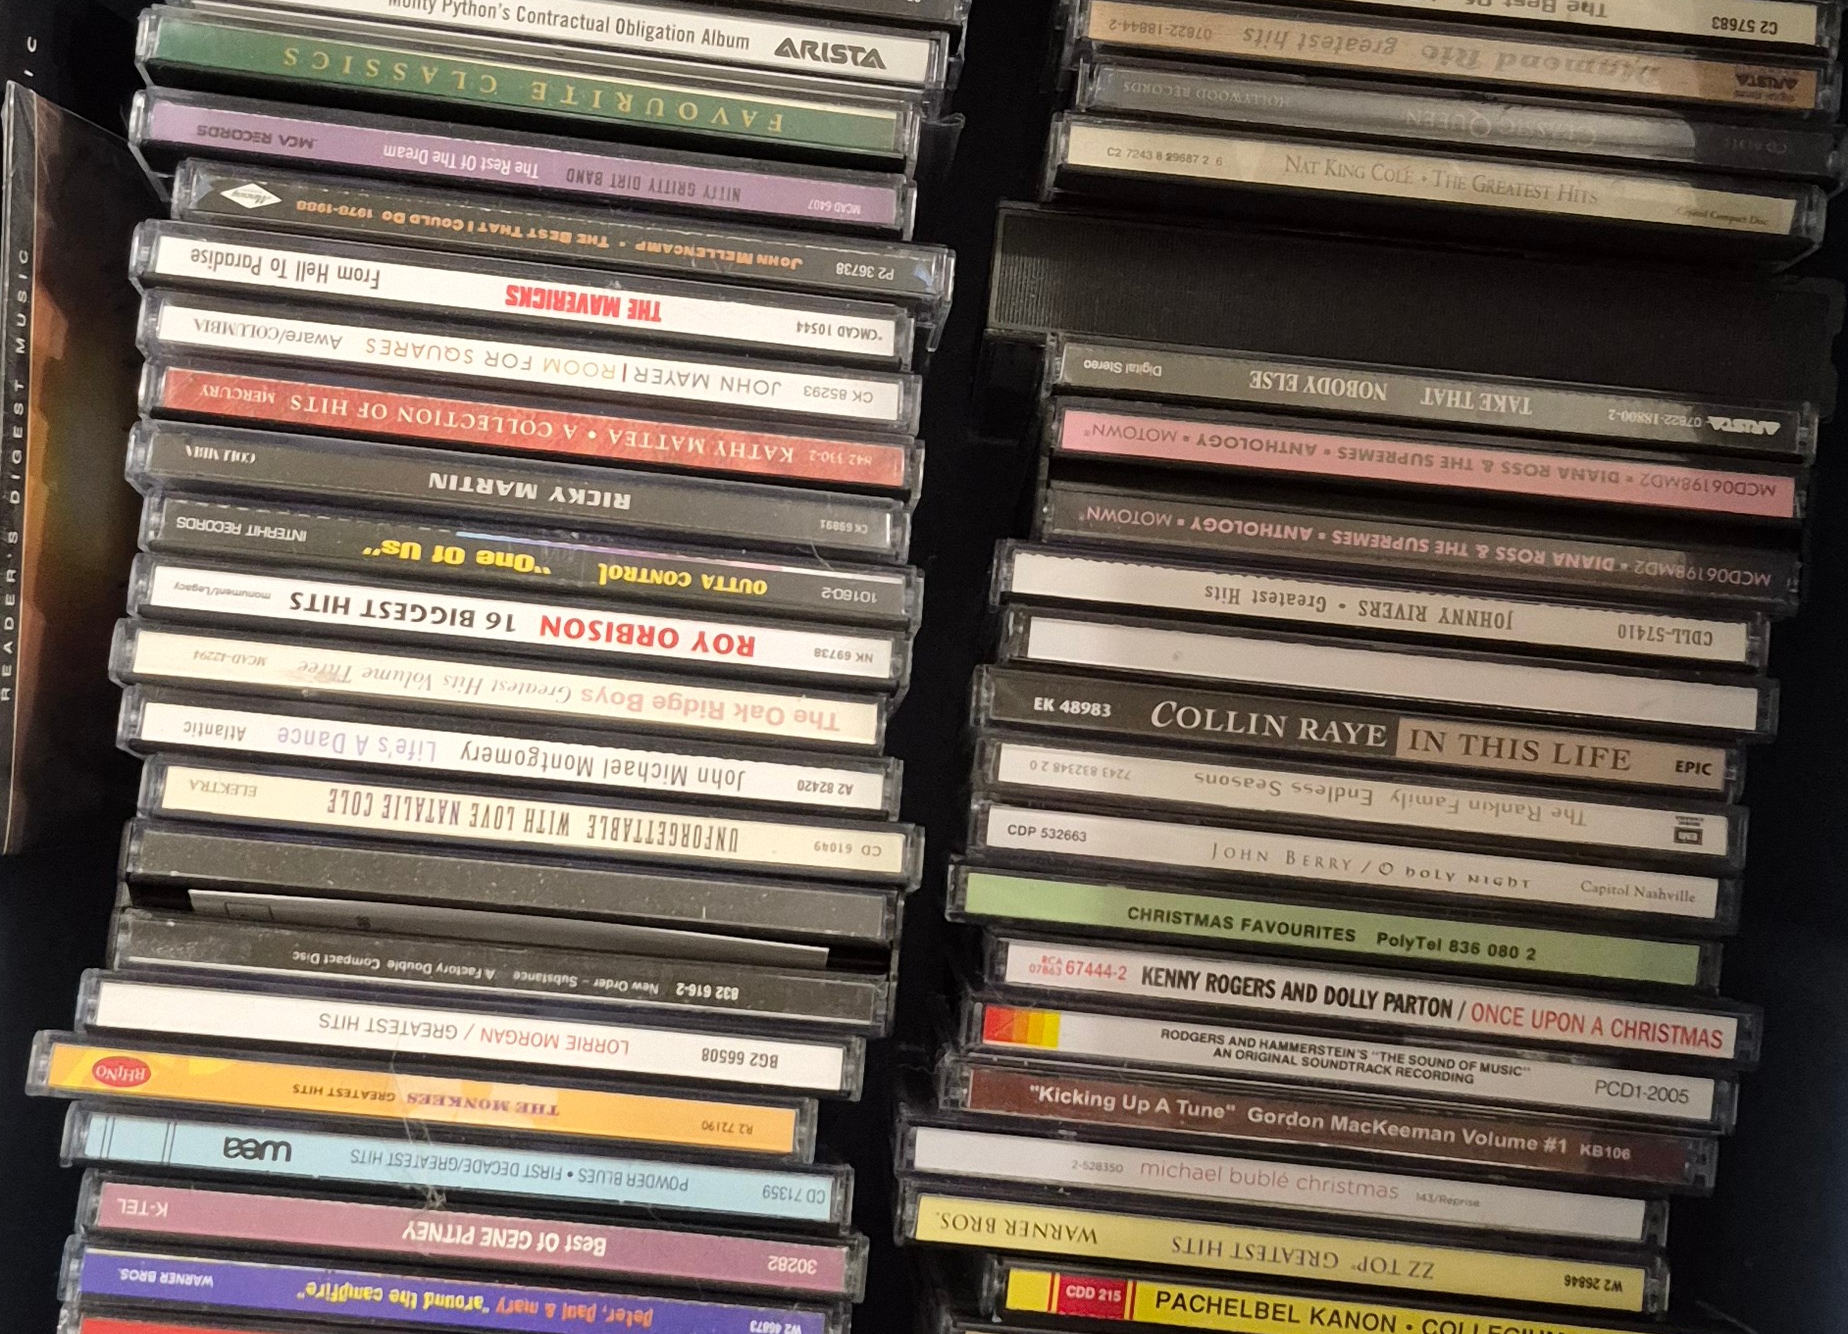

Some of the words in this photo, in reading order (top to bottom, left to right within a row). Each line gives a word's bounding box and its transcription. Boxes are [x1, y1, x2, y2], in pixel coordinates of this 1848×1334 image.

[1566, 0, 1607, 18] The
[516, 5, 609, 32] Contractual
[615, 17, 694, 43] Obligation
[701, 28, 749, 49] Album
[774, 37, 887, 69] ARISTA
[190, 248, 261, 275] Paradise
[270, 257, 287, 279] To
[295, 260, 329, 283] Hell
[337, 265, 380, 289] From
[504, 284, 622, 317] MAVERICKS
[626, 298, 663, 322] THE
[1249, 370, 1298, 391] ELSE
[1302, 375, 1387, 400] NOBODY
[1420, 387, 1474, 409] THAT
[1479, 392, 1531, 414] TAKE
[608, 428, 704, 454] MATTEA
[714, 440, 793, 462] KATHY
[428, 472, 537, 499] MARTIN
[548, 486, 630, 509] RICKY
[289, 591, 350, 615] HITS
[359, 599, 475, 627] BIGGEST
[485, 611, 515, 632] 16
[539, 615, 679, 648] ORBISON
[690, 630, 755, 657] ROY
[1617, 624, 1712, 646] CDLL-57410
[1033, 696, 1054, 711] EK
[1059, 699, 1110, 717] 48983
[1150, 700, 1287, 737] COLLIN
[1298, 717, 1386, 746] RAYE
[460, 740, 593, 777] Montgomery
[1408, 729, 1446, 752] IN
[1458, 733, 1539, 761] THIS
[1552, 742, 1630, 770] LIFE
[603, 758, 687, 786] Michael
[697, 767, 745, 791] John
[1675, 760, 1712, 775] EPIC
[1127, 906, 1233, 929] CHRISTMAS
[1240, 917, 1355, 942] FAVOURITES
[1376, 931, 1441, 951] PolyTel
[1448, 939, 1480, 954] 836
[1487, 943, 1519, 959] 080
[1526, 947, 1536, 961] 2
[1141, 966, 1200, 990] KENNY
[1205, 972, 1275, 998] ROGERS
[1280, 980, 1317, 1003] AND
[1323, 985, 1378, 1009] DOLLY
[1382, 991, 1452, 1018] PARTON
[1471, 1002, 1524, 1026] ONCE
[1531, 1009, 1584, 1033] UPON
[1590, 1016, 1603, 1035] A
[1610, 1018, 1723, 1049] CHRISTMAS
[701, 1047, 744, 1065] 66508
[749, 1052, 778, 1068] BG2
[407, 1093, 508, 1111] MONKEES
[1594, 1079, 1688, 1104] PCD1-2005
[516, 1102, 560, 1116] THE
[1029, 1084, 1115, 1111] "Kicking
[1122, 1093, 1150, 1114] Up
[1154, 1097, 1170, 1113] A
[1176, 1099, 1235, 1118] Tune"
[1247, 1106, 1323, 1128] Gordon
[1330, 1114, 1455, 1142] MacKeeman
[1462, 1128, 1538, 1150] Volume
[1543, 1136, 1566, 1153] #1
[1579, 1143, 1630, 1163] KB106
[116, 1197, 168, 1217] K-TEL
[402, 1221, 475, 1244] PITNEY
[479, 1226, 532, 1249] GENE
[535, 1232, 559, 1252] Of
[564, 1234, 606, 1256] Best
[767, 1255, 817, 1274] 30282
[1065, 1284, 1095, 1298] CDD
[1098, 1288, 1121, 1301] 215
[1155, 1290, 1300, 1323] PACHELBEL
[1309, 1306, 1396, 1333] KANON
